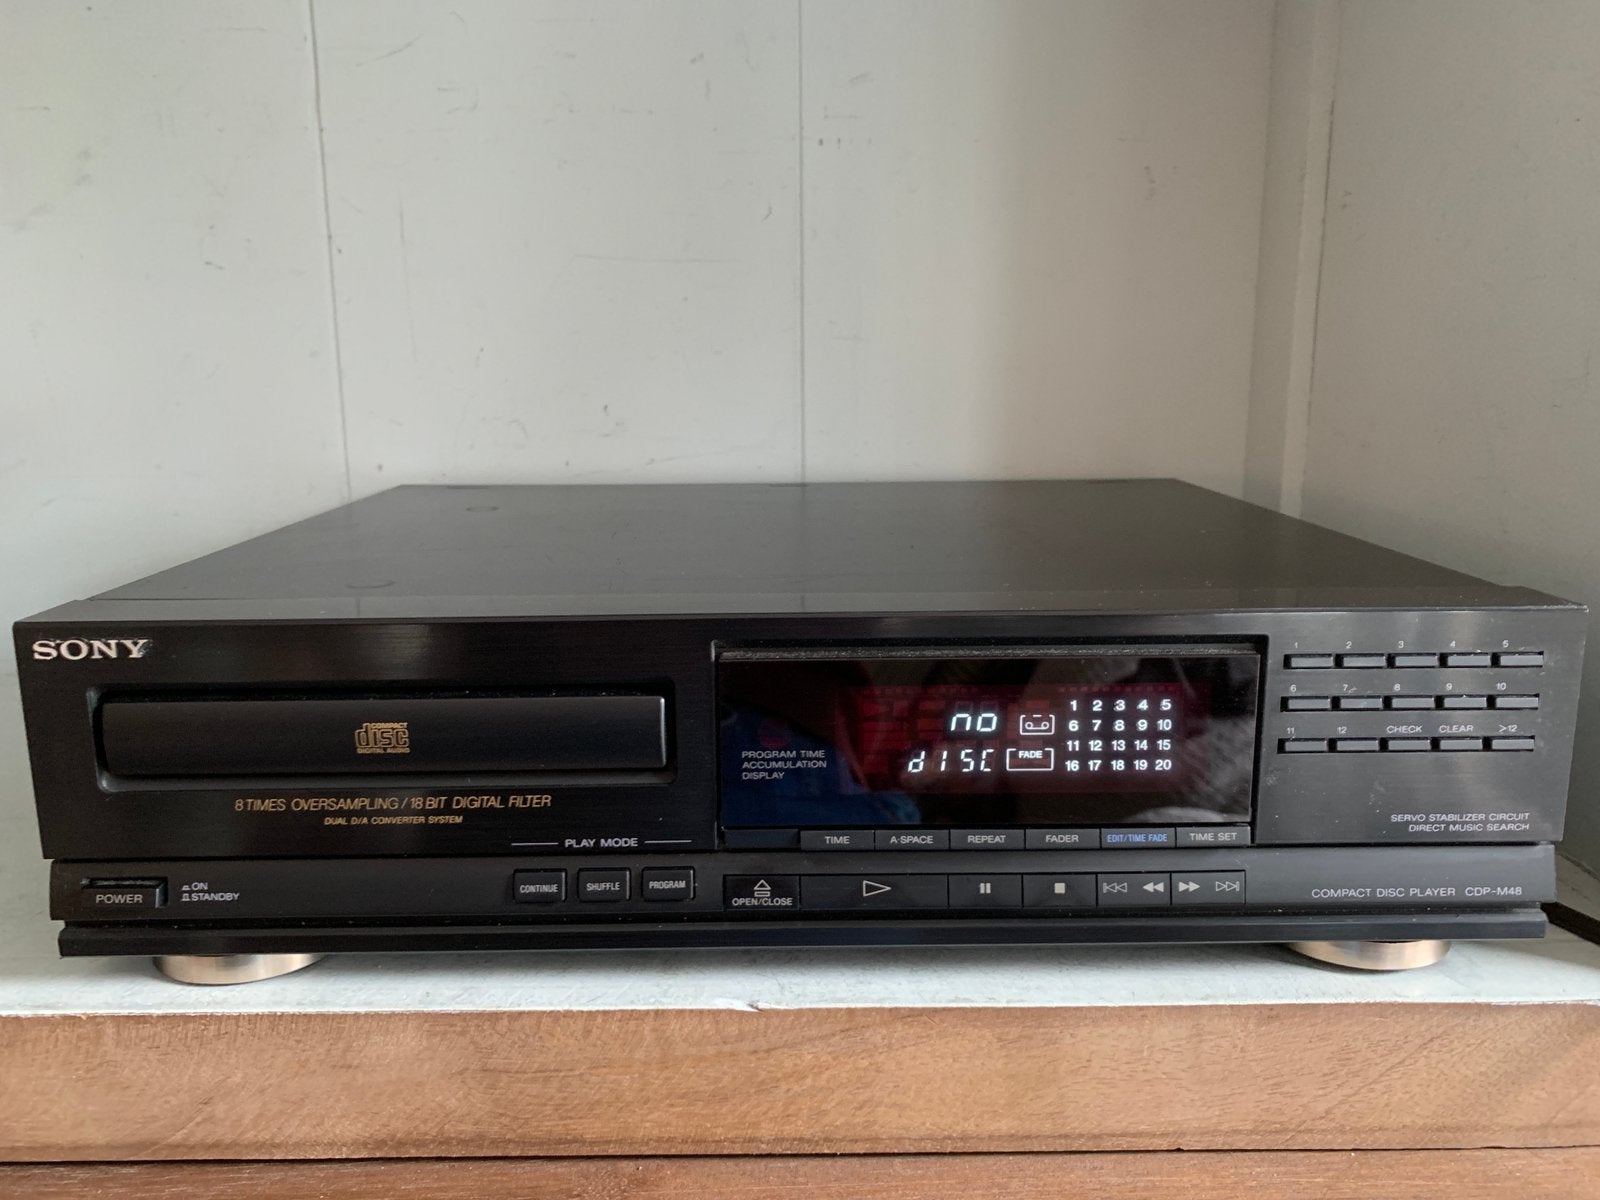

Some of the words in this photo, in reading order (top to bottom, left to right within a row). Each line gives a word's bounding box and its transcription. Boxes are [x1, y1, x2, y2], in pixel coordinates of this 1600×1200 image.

[1345, 641, 1352, 649] 2
[1398, 641, 1405, 649] 3
[1450, 640, 1457, 648] 4
[1502, 640, 1510, 648] 5
[32, 639, 149, 660] SONY
[1290, 684, 1297, 692] 6
[1342, 684, 1349, 692] 7
[1393, 683, 1401, 691] 8
[1446, 682, 1453, 691] 9
[1496, 682, 1507, 691] 10
[1070, 700, 1077, 711] 1
[1092, 700, 1102, 711] 2
[1114, 699, 1126, 711] 3
[1138, 699, 1149, 710] 4
[1161, 699, 1172, 711] 5
[950, 713, 998, 732] no
[1068, 720, 1079, 731] 6
[1092, 720, 1102, 731] 7
[1114, 719, 1125, 731] 8
[1137, 719, 1148, 731] 9
[1157, 719, 1172, 731] 10
[1286, 727, 1295, 735] 11
[1337, 727, 1347, 735] 12
[1386, 725, 1423, 734] CHECK
[1439, 724, 1474, 733] CLEAR
[1066, 740, 1079, 751] 11
[1088, 740, 1102, 751] 12
[1111, 740, 1126, 751] 13
[1134, 740, 1148, 751] 14
[1157, 739, 1171, 751] 15
[742, 751, 796, 759] PROGRAM
[800, 750, 825, 759] TIME
[1018, 750, 1043, 760] FADE
[742, 760, 827, 770] ACCUMULATION
[1065, 760, 1079, 772] 16
[1088, 760, 1102, 771] 17
[1110, 760, 1125, 771] 18
[1133, 759, 1148, 771] 19
[1154, 759, 1172, 771] 20
[742, 771, 785, 781] DISPLAY
[425, 796, 448, 809] BIT
[452, 796, 505, 809] DIGITAL
[508, 795, 552, 808] FILTER
[324, 817, 348, 825] DUAL
[351, 816, 369, 825] D/A
[371, 816, 425, 825] CONVERTER
[428, 815, 463, 824] SYSTEM
[1390, 814, 1426, 822] SERVO
[1428, 813, 1486, 822] STABILIZER
[1488, 812, 1530, 821] CIRCUIT
[1408, 824, 1446, 832] DIRECT
[1449, 823, 1483, 832] MUSIC
[1486, 823, 1530, 831] SEARCH
[825, 835, 850, 844] TIME
[967, 835, 1006, 844] REPEAT
[1045, 834, 1079, 843] FADER
[1107, 834, 1146, 843] EDIT/TIME
[1149, 833, 1168, 842] FADE
[1189, 832, 1215, 841] TIME
[1217, 832, 1237, 841] SET
[564, 838, 596, 848] PLAY
[600, 837, 639, 847] MODE
[191, 882, 208, 890] ON
[520, 884, 559, 894] CONTINUE
[586, 882, 621, 892] SHUFFLE
[649, 880, 686, 890] PROGRAM
[191, 892, 240, 901] STANDBY
[1311, 888, 1371, 898] COMPACT
[1376, 888, 1405, 897] DISC
[1409, 887, 1456, 897] PLAYER
[1465, 886, 1523, 896] CDP-M48
[96, 894, 143, 904] POWER
[731, 897, 793, 906] OPEN/CLOSE
